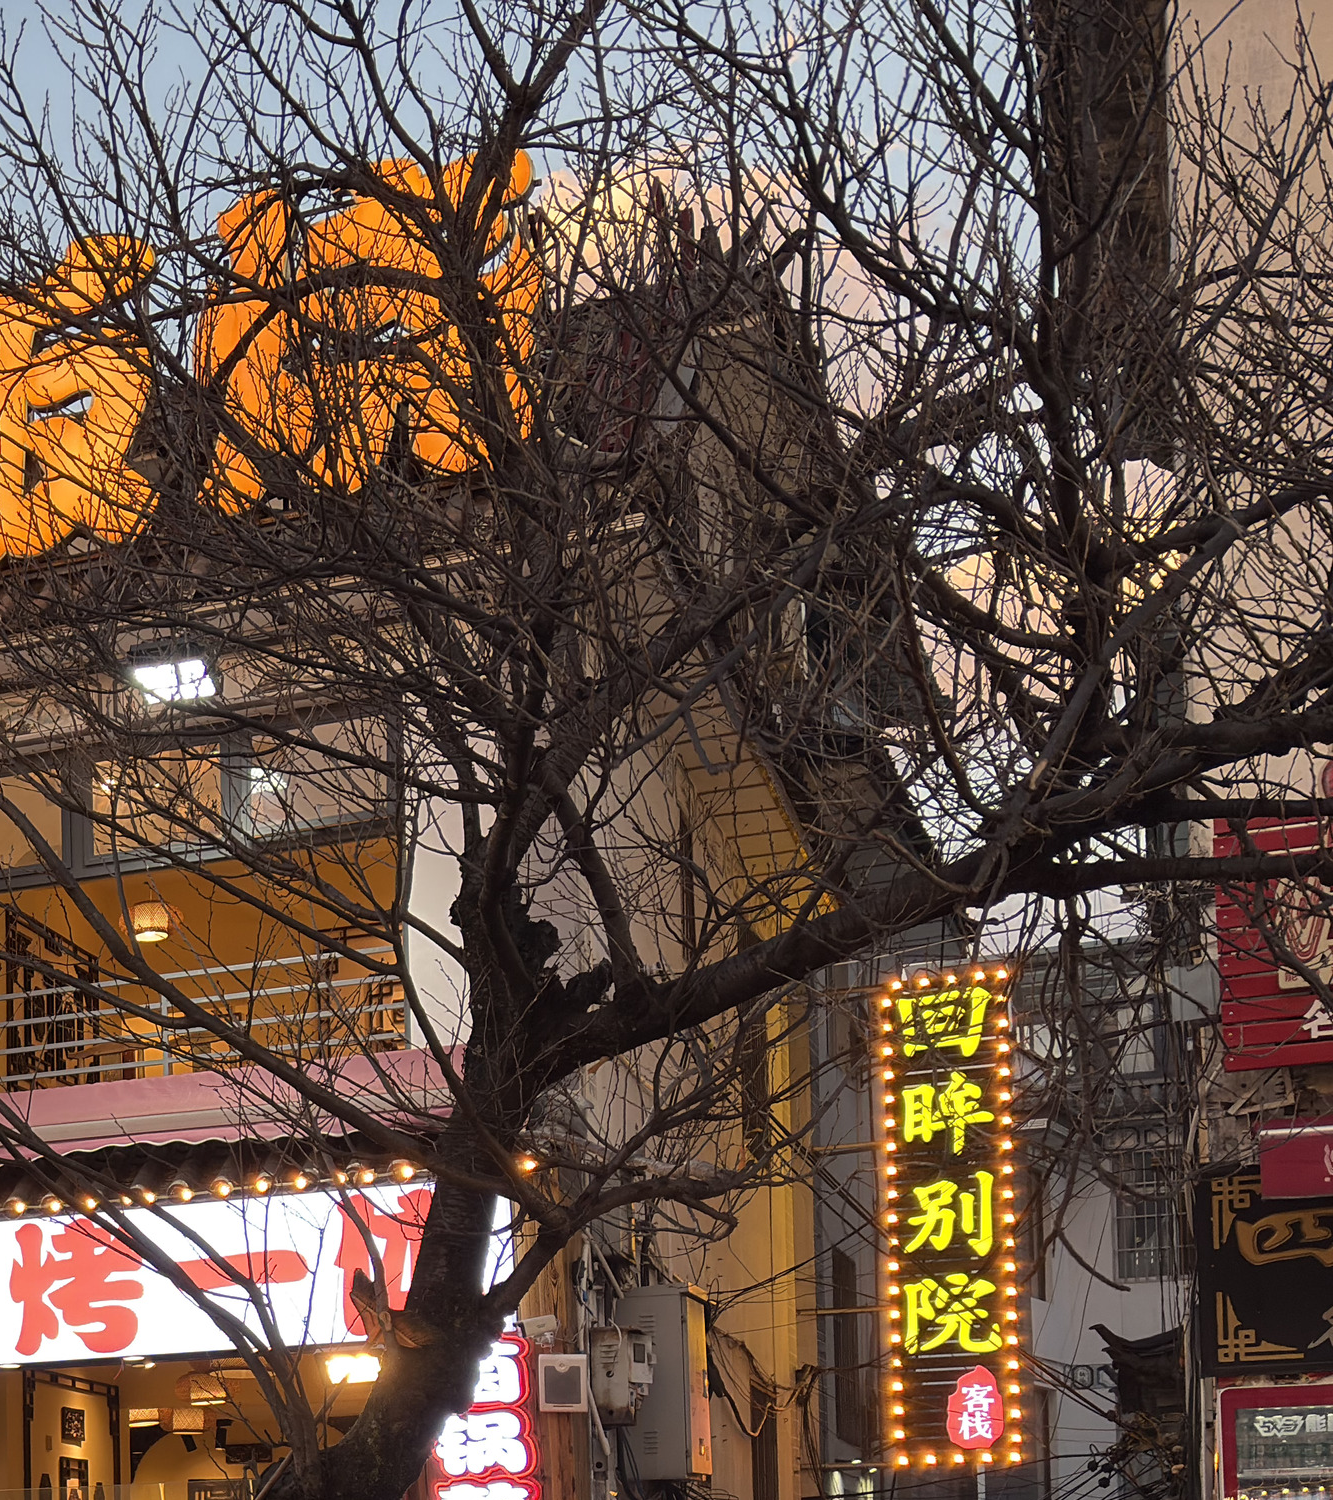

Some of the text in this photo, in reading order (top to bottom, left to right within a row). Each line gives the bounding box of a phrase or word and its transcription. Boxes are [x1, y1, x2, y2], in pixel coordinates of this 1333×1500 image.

[895, 986, 1003, 1356] 回眸别院
[957, 1383, 995, 1441] 客栈
